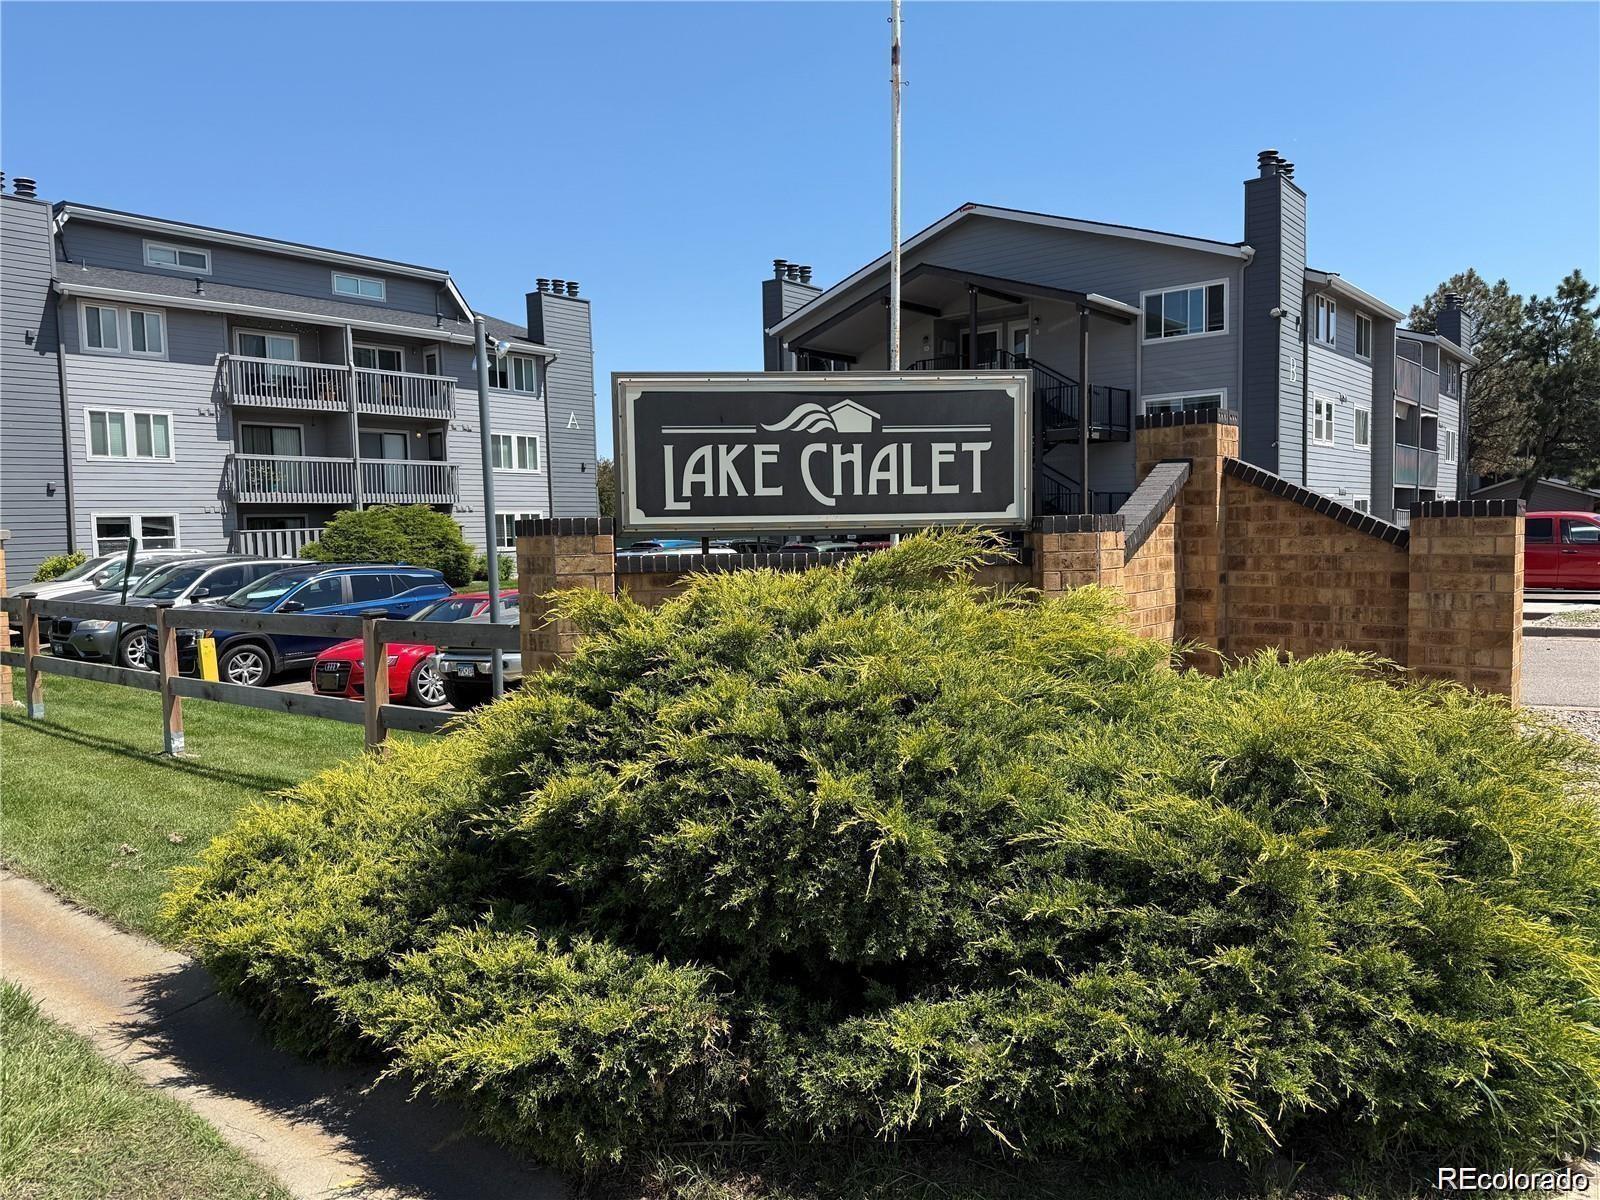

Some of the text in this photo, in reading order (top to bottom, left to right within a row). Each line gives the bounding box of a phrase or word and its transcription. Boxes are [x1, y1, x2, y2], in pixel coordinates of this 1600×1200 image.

[1289, 357, 1297, 382] B
[566, 410, 580, 430] A
[663, 440, 992, 510] LAKE CHALET
